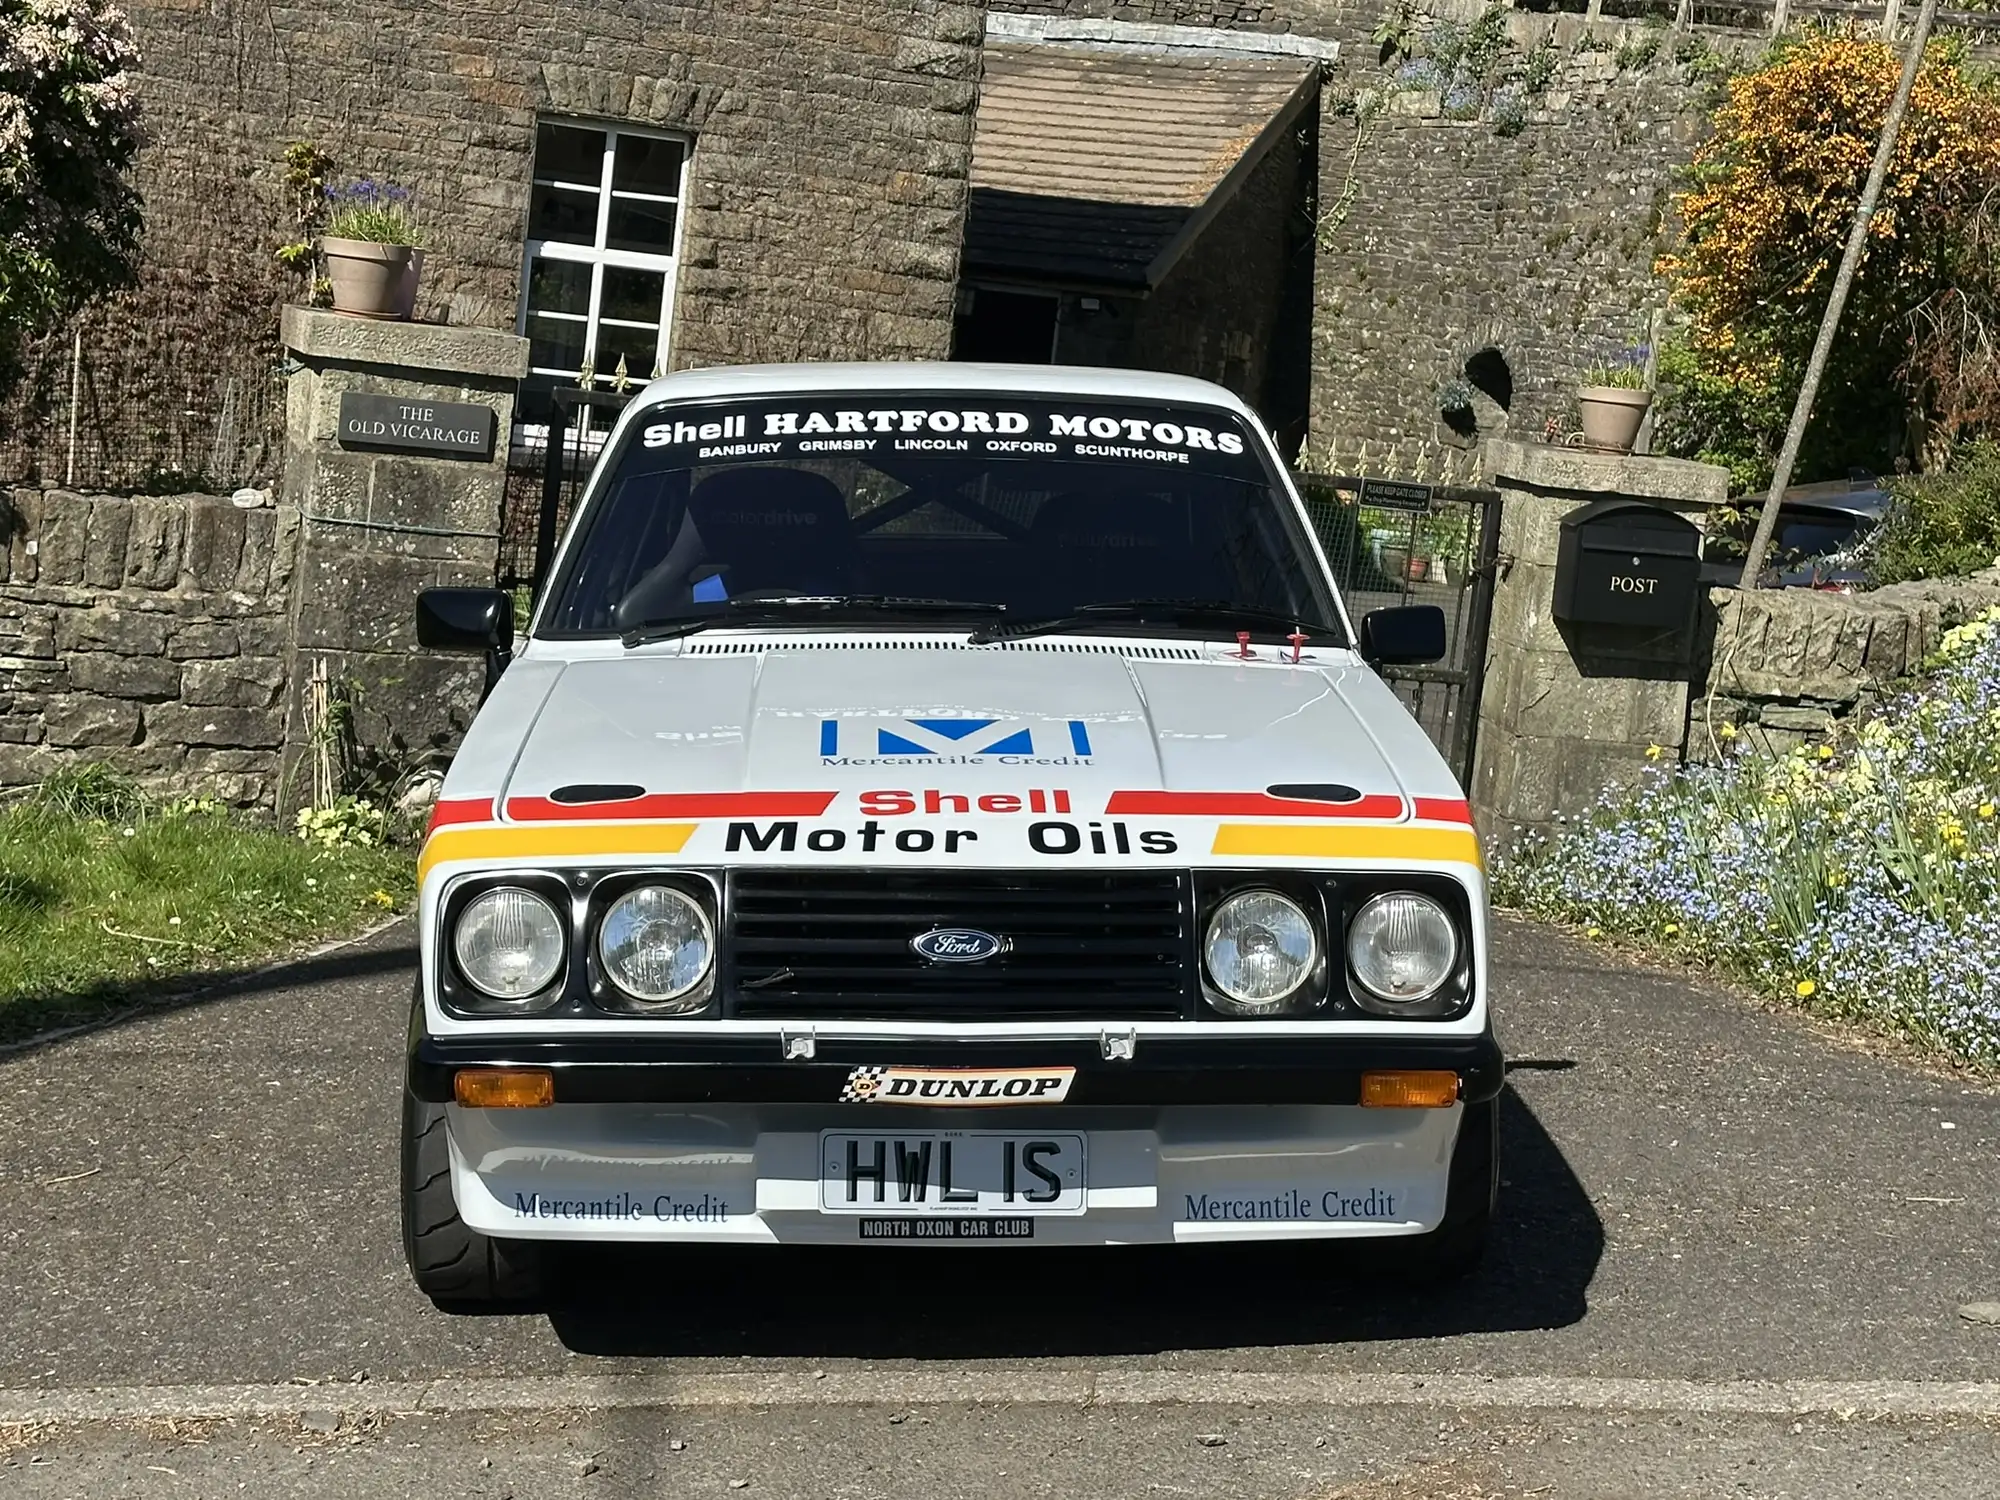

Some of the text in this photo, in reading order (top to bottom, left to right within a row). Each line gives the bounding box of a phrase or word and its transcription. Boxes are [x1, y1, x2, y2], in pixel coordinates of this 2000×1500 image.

[400, 405, 434, 422] THE
[349, 419, 480, 444] OLD VICARAGE
[643, 410, 1244, 455] Shell HARTFORD MOTORS
[699, 439, 1190, 464] BANBURY GRIMSBY LINCOLN OXFORD SCUNTHORPE
[1367, 484, 1384, 495] PLEASE
[1609, 575, 1659, 594] POST
[822, 755, 1096, 767] Mercantile Credit
[859, 789, 1071, 816] Shell
[725, 821, 1178, 855] Motor Oils
[934, 934, 981, 954] Ford
[886, 1077, 1062, 1098] DUNLOP
[846, 1140, 979, 1202] HWL
[514, 1192, 729, 1223] Mercantile Credit
[1185, 1187, 1396, 1220] Mercantile Credit
[864, 1219, 1030, 1237] NORTH OXON CAR CLUB
